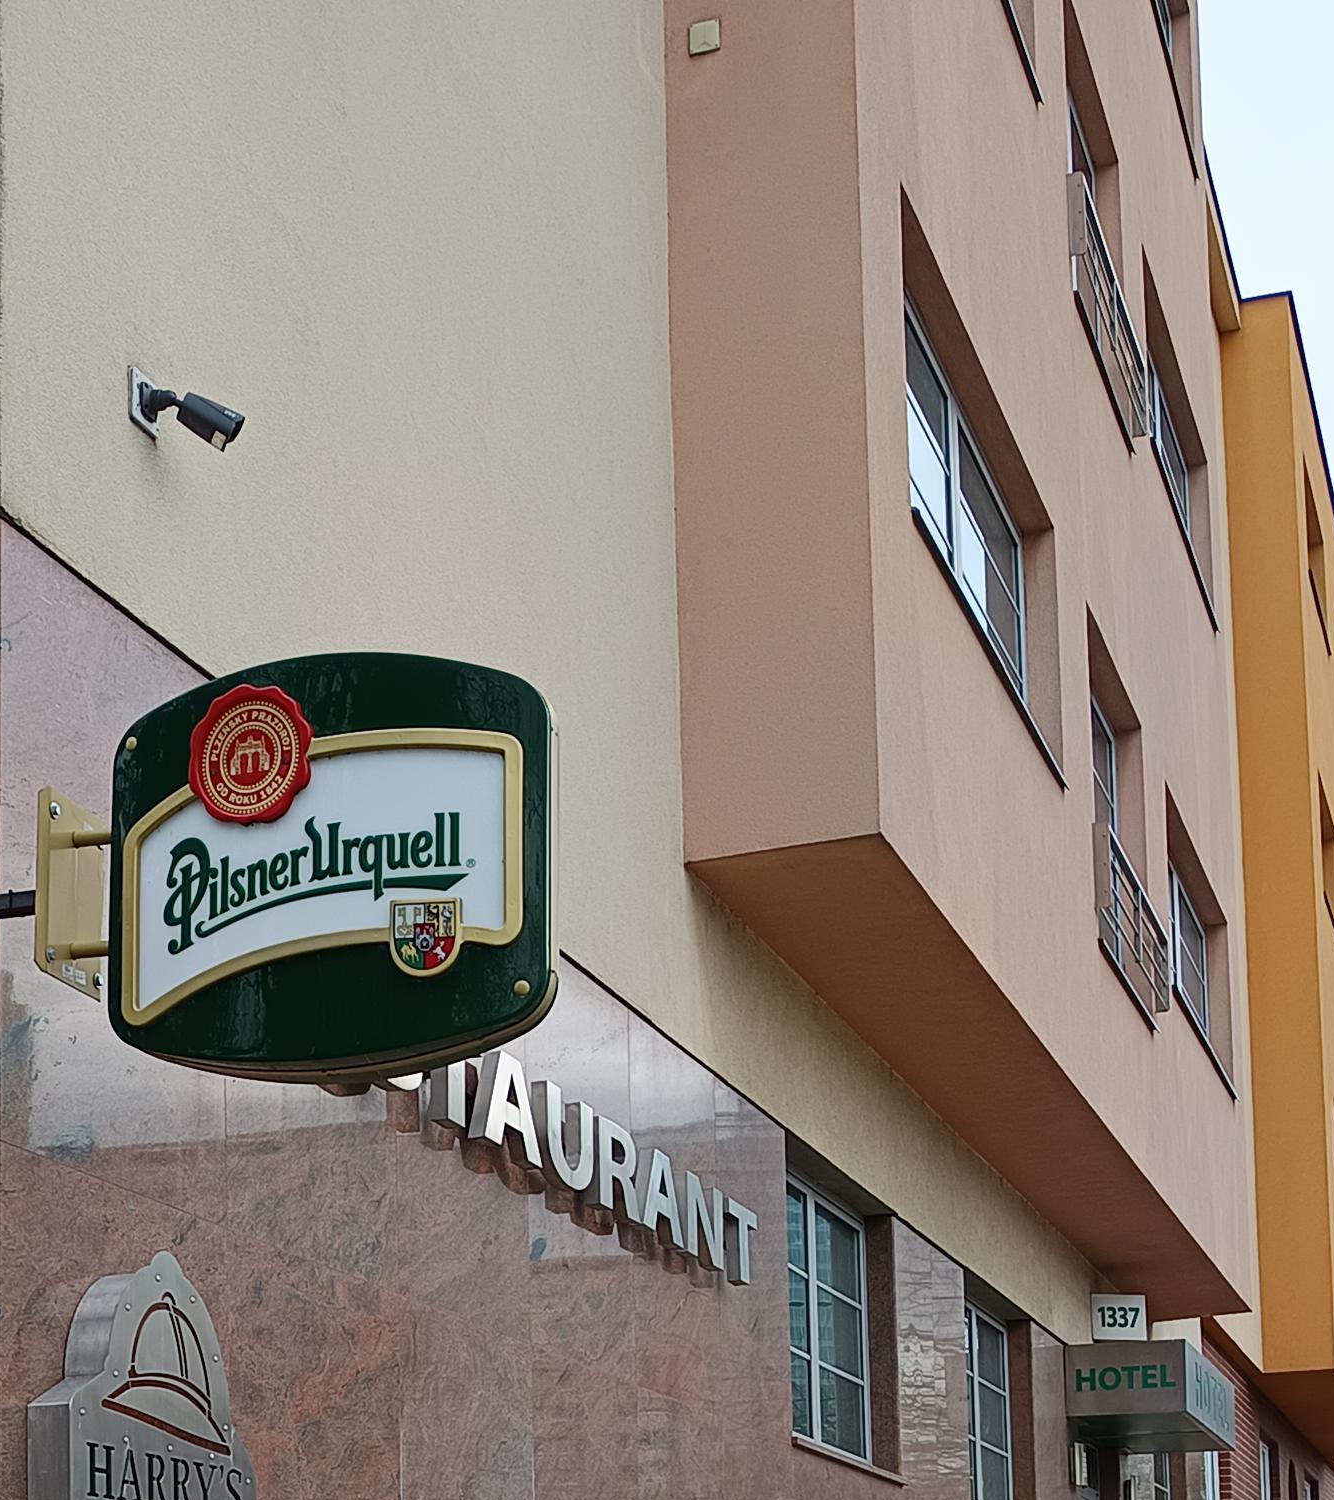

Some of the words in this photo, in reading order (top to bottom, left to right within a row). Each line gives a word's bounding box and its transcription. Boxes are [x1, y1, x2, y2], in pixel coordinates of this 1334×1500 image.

[252, 711, 291, 751] PRAZDROJ
[216, 782, 228, 797] OD
[229, 793, 257, 805] ROKU
[260, 775, 283, 800] 1842
[163, 837, 310, 955] Pilsner
[304, 812, 462, 901] Urquell
[386, 1050, 758, 1287] TAURANT
[1097, 1306, 1140, 1328] 1337
[1075, 1364, 1176, 1393] HOTEL
